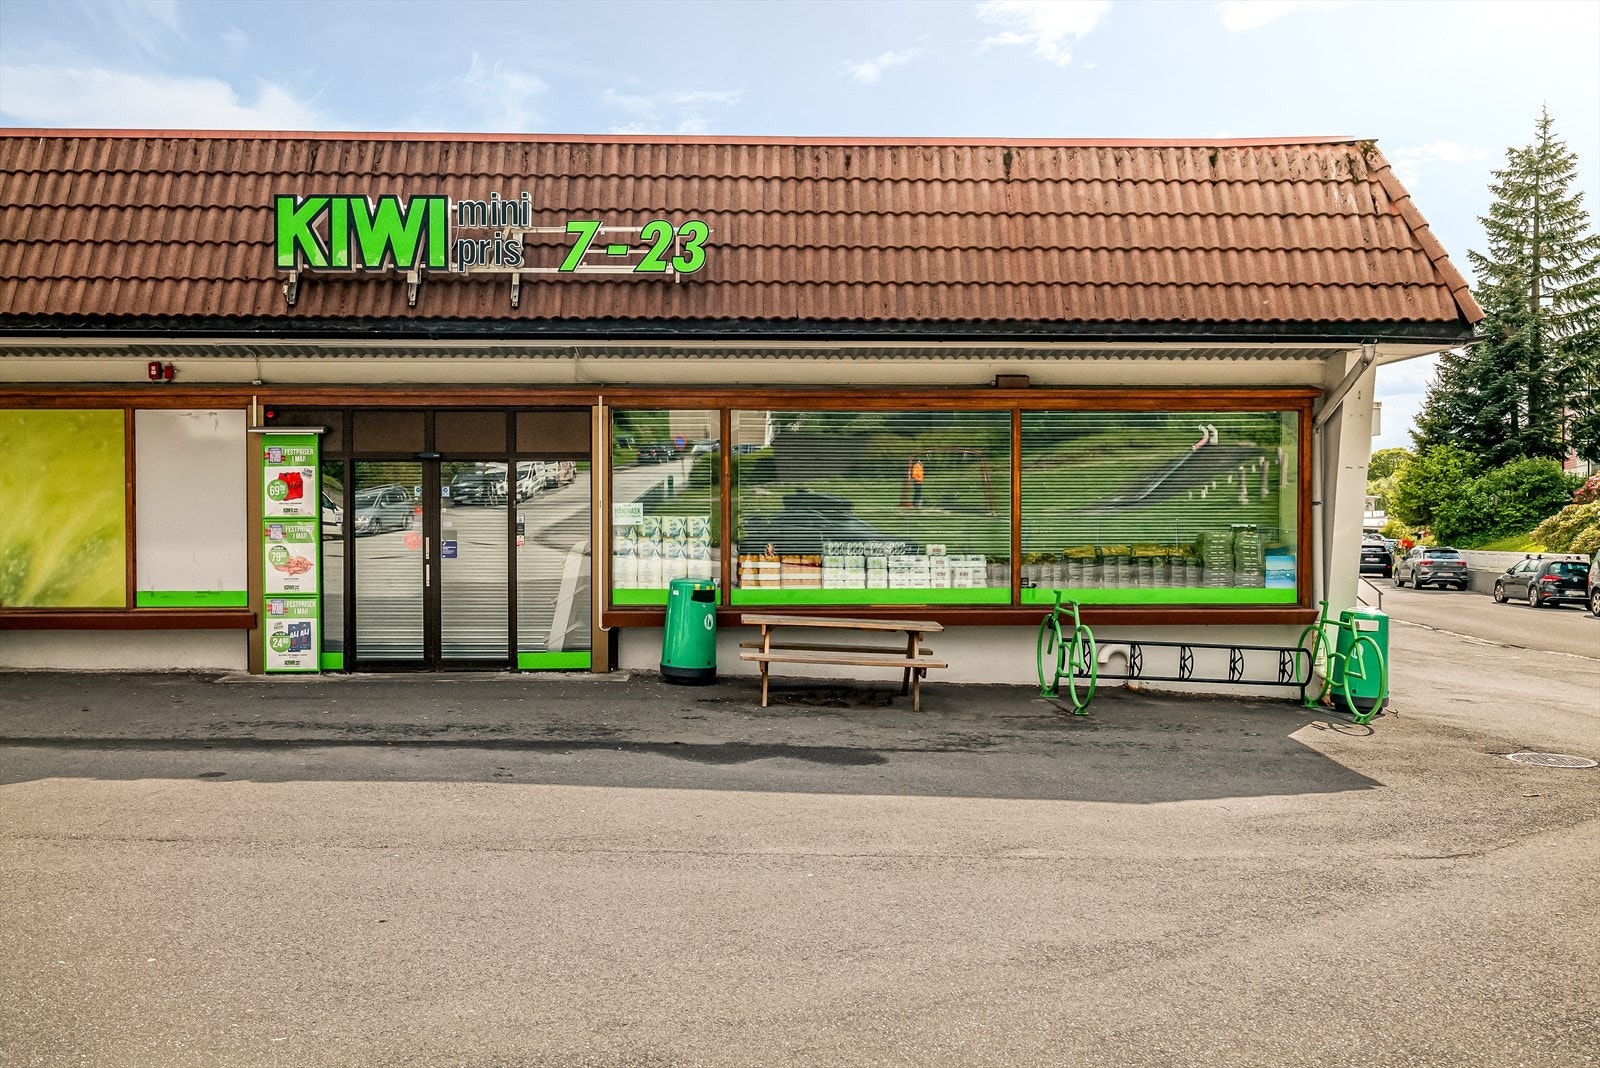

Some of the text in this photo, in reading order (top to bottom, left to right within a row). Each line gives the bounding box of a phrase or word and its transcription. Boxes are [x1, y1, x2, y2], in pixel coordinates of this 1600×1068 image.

[457, 192, 530, 229] mini
[274, 194, 450, 272] KIWI
[457, 231, 522, 272] pris
[558, 221, 602, 273] 7
[633, 220, 709, 274] 23
[290, 630, 300, 639] ALI
[300, 628, 310, 637] ALI
